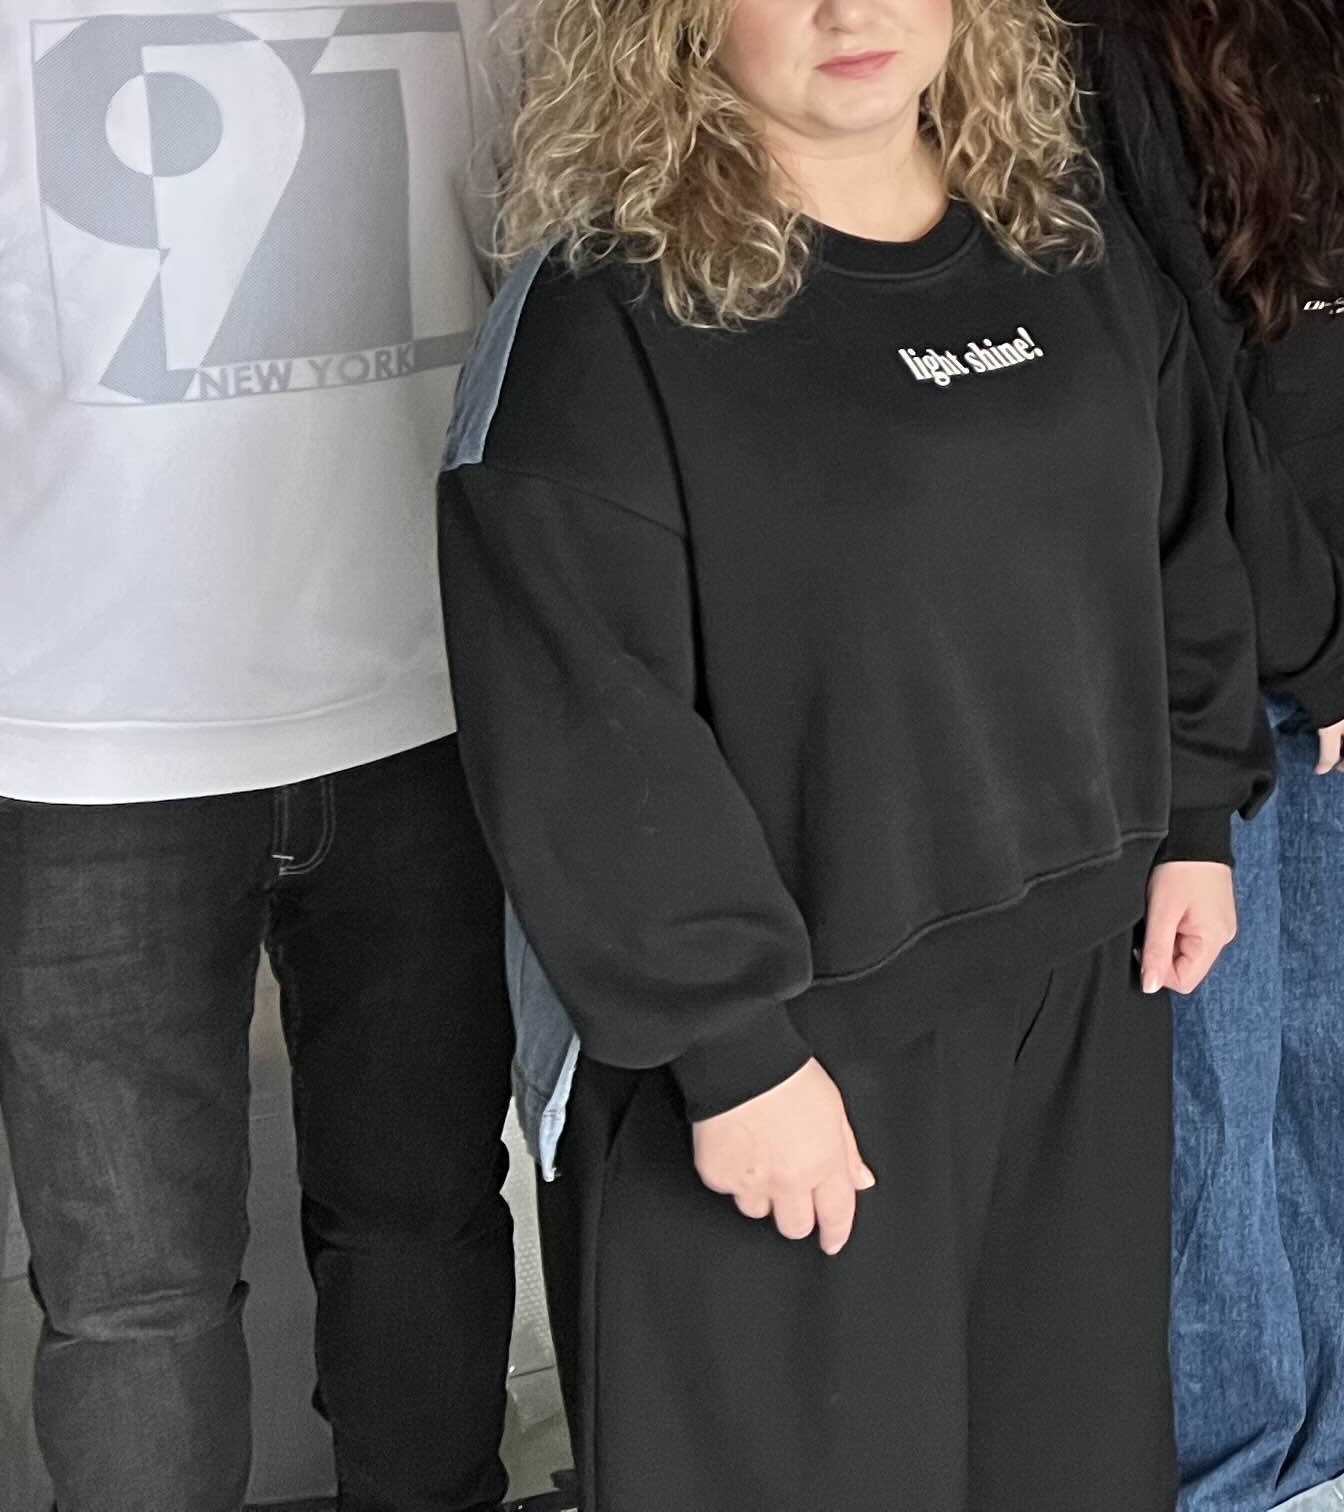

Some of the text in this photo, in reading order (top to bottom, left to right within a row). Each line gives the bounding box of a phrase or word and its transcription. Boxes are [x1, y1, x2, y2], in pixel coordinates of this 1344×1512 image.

[199, 342, 416, 399] NEW YORK
[898, 326, 1045, 387] light shine!
